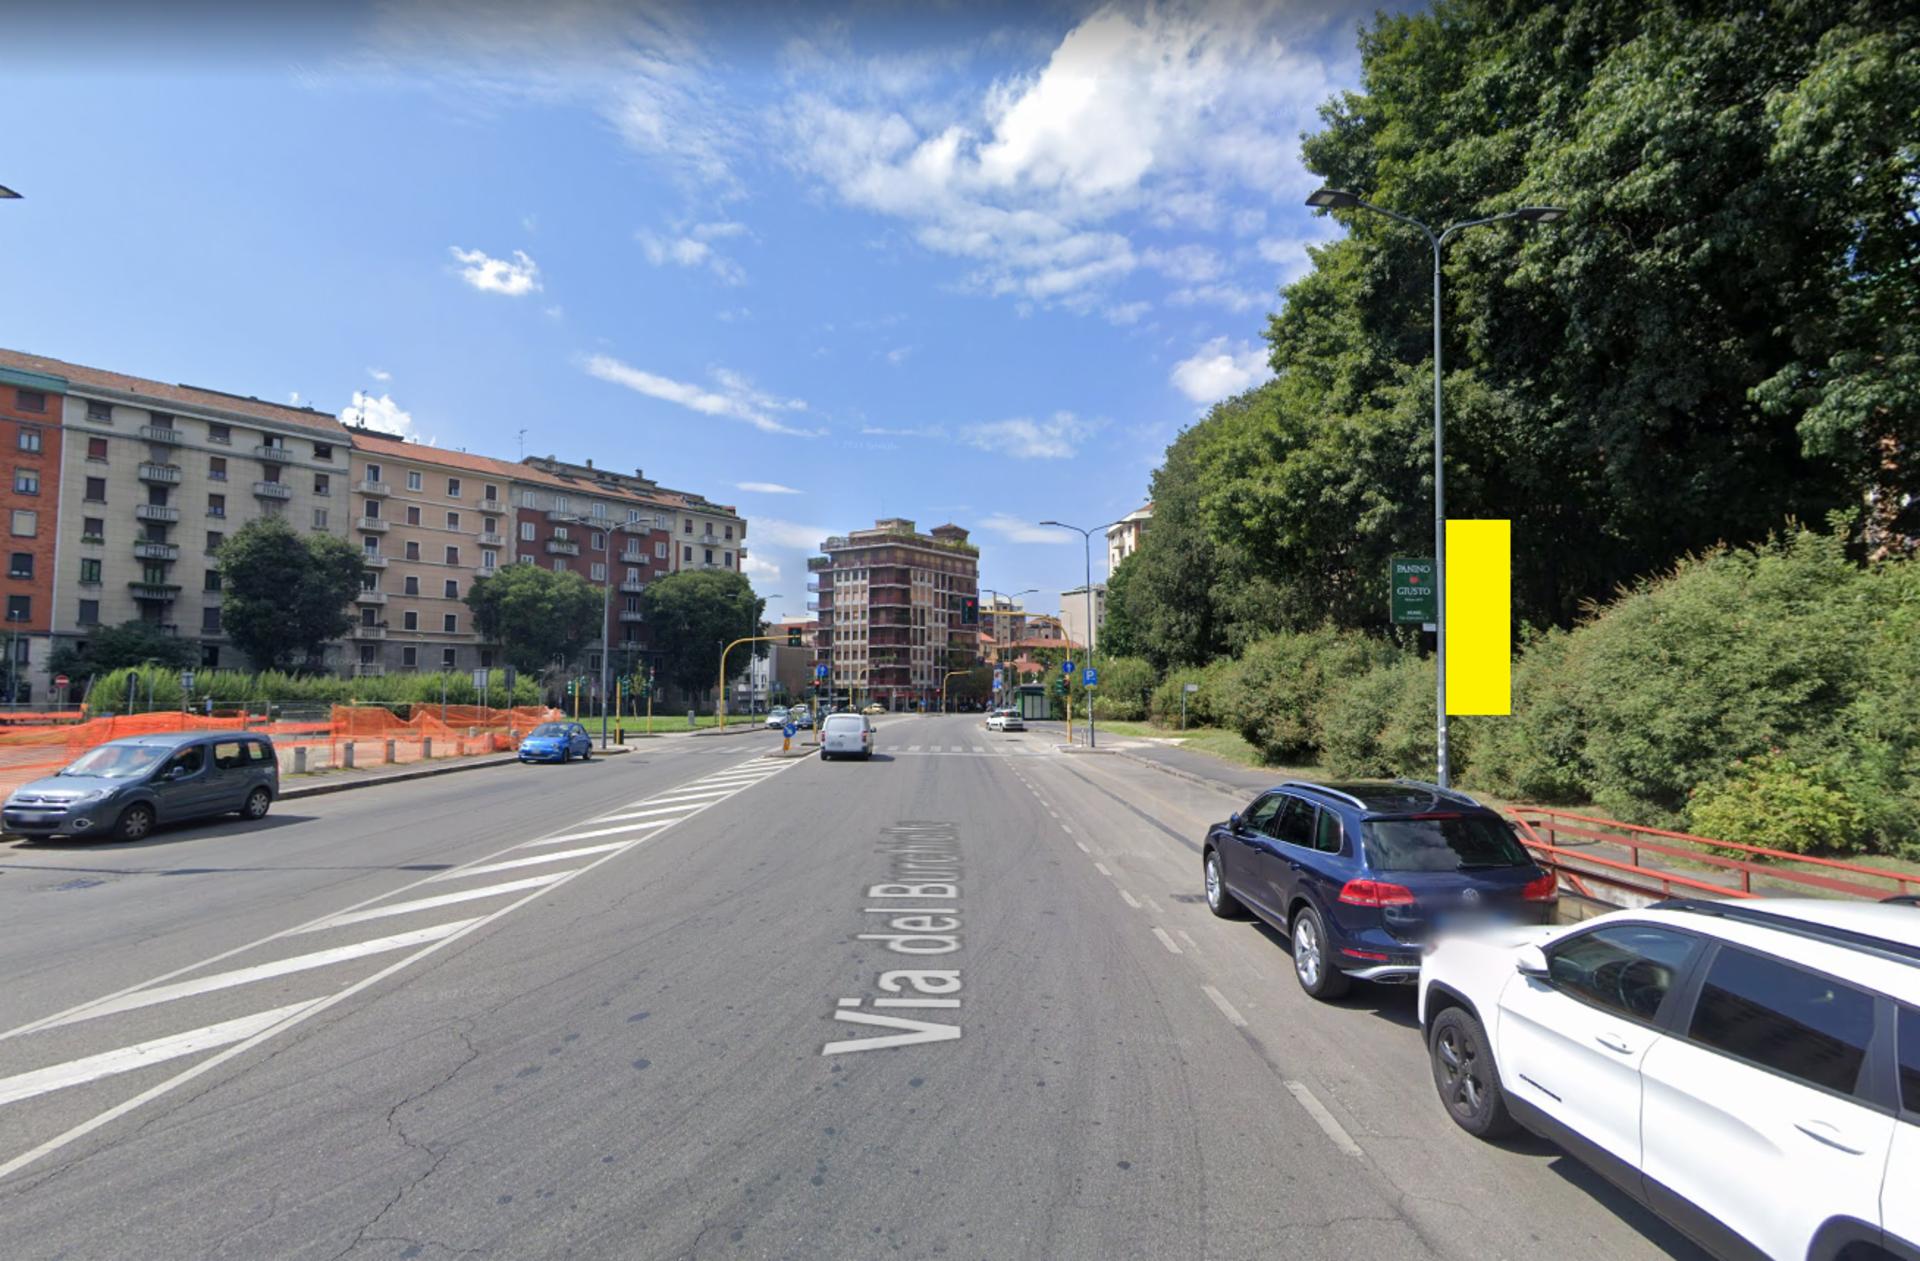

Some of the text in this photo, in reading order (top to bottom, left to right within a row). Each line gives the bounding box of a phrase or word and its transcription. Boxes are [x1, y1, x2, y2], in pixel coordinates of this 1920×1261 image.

[1396, 564, 1431, 574] PANINO
[1396, 586, 1431, 596] GIUSTO
[1086, 670, 1095, 681] P
